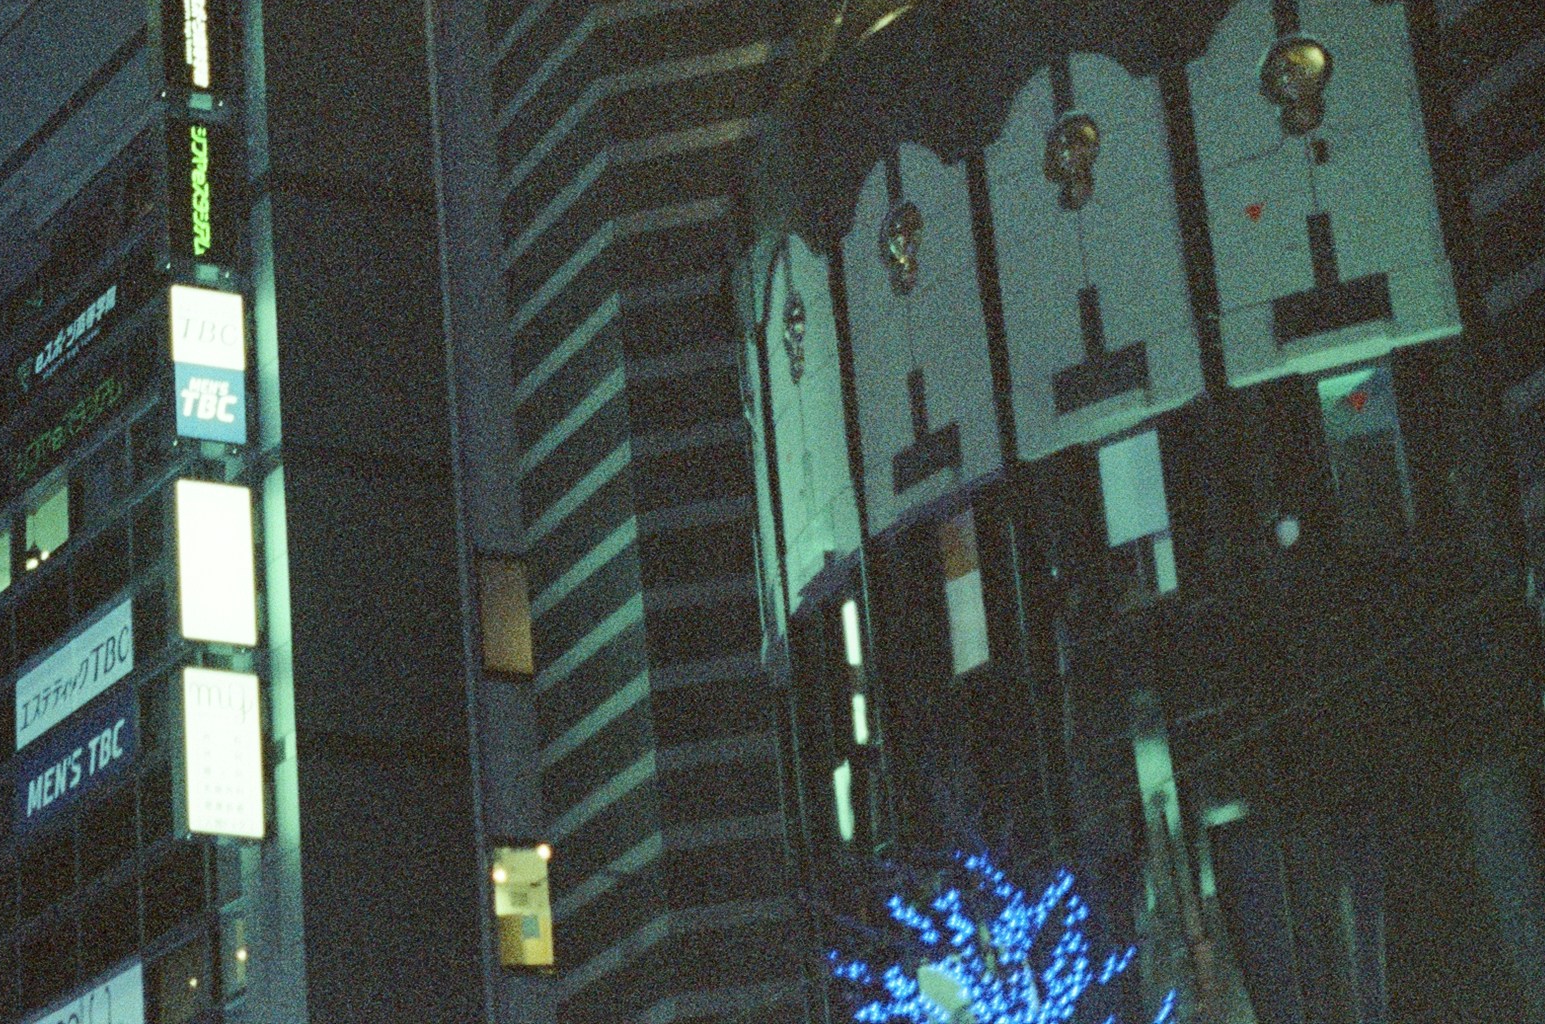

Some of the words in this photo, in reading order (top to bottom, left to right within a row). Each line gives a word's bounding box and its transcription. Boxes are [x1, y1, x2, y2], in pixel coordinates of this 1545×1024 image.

[178, 316, 239, 346] TBC
[188, 377, 229, 396] MEN'S
[181, 388, 238, 423] TBC
[27, 747, 83, 817] MEN'S
[88, 719, 125, 776] TBC
